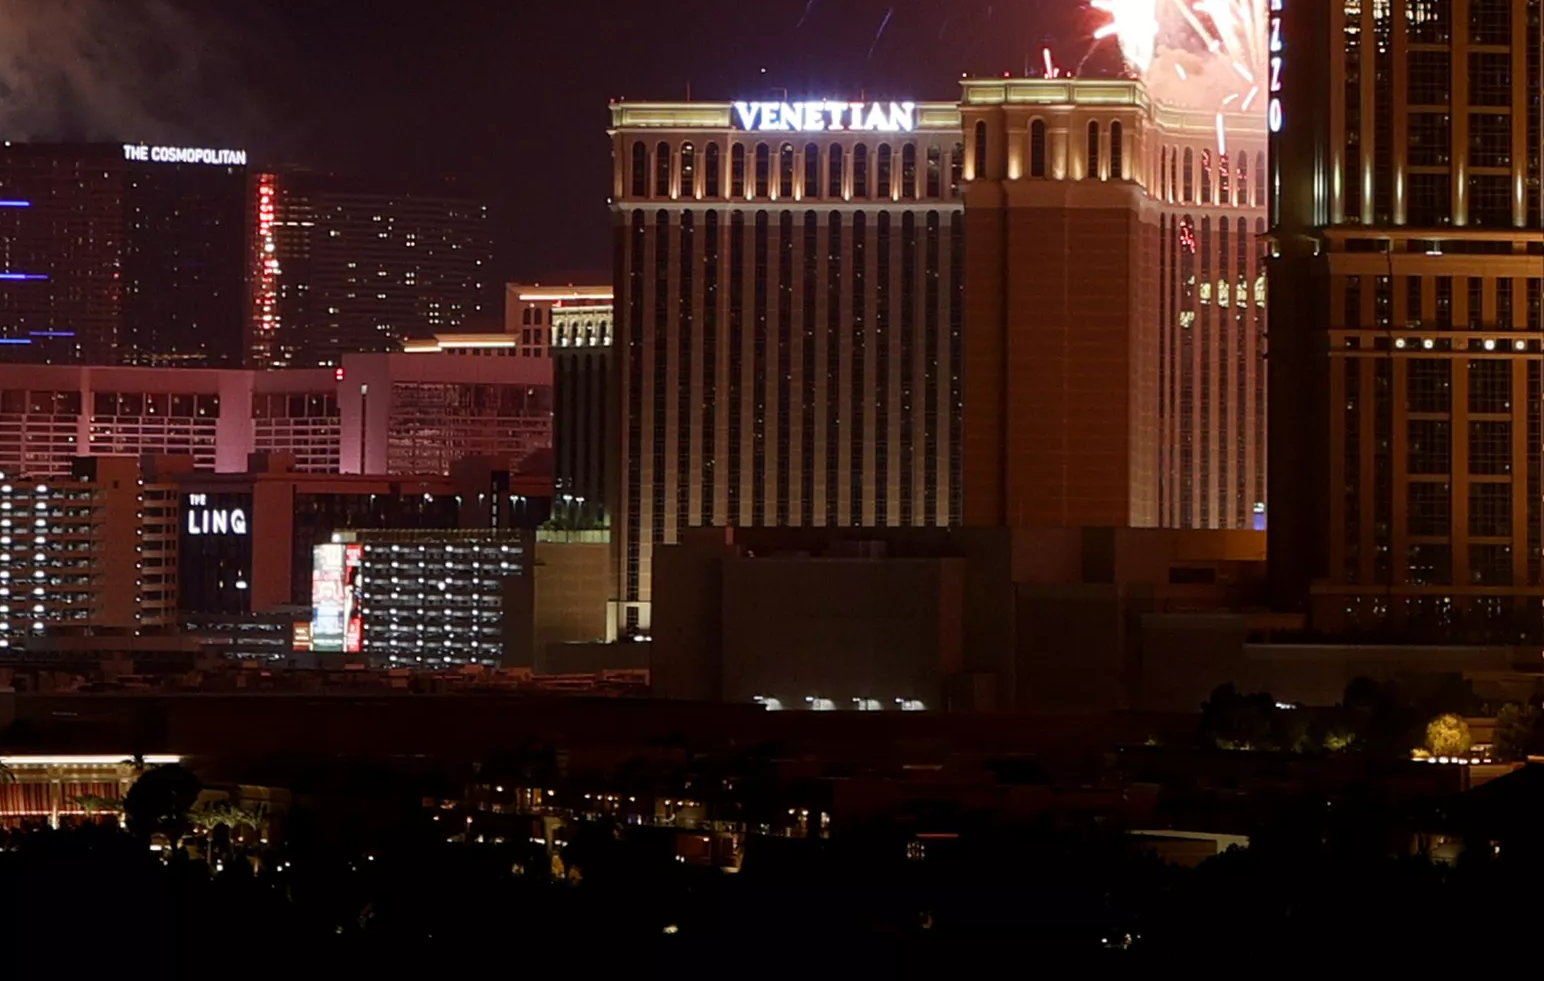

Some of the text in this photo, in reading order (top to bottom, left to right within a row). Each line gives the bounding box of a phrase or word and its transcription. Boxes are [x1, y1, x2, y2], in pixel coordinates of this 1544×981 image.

[733, 101, 916, 131] VENETIAN
[123, 144, 247, 165] THE COSMOPOLITAN
[189, 494, 206, 506] THE
[188, 508, 247, 535] LINQ
